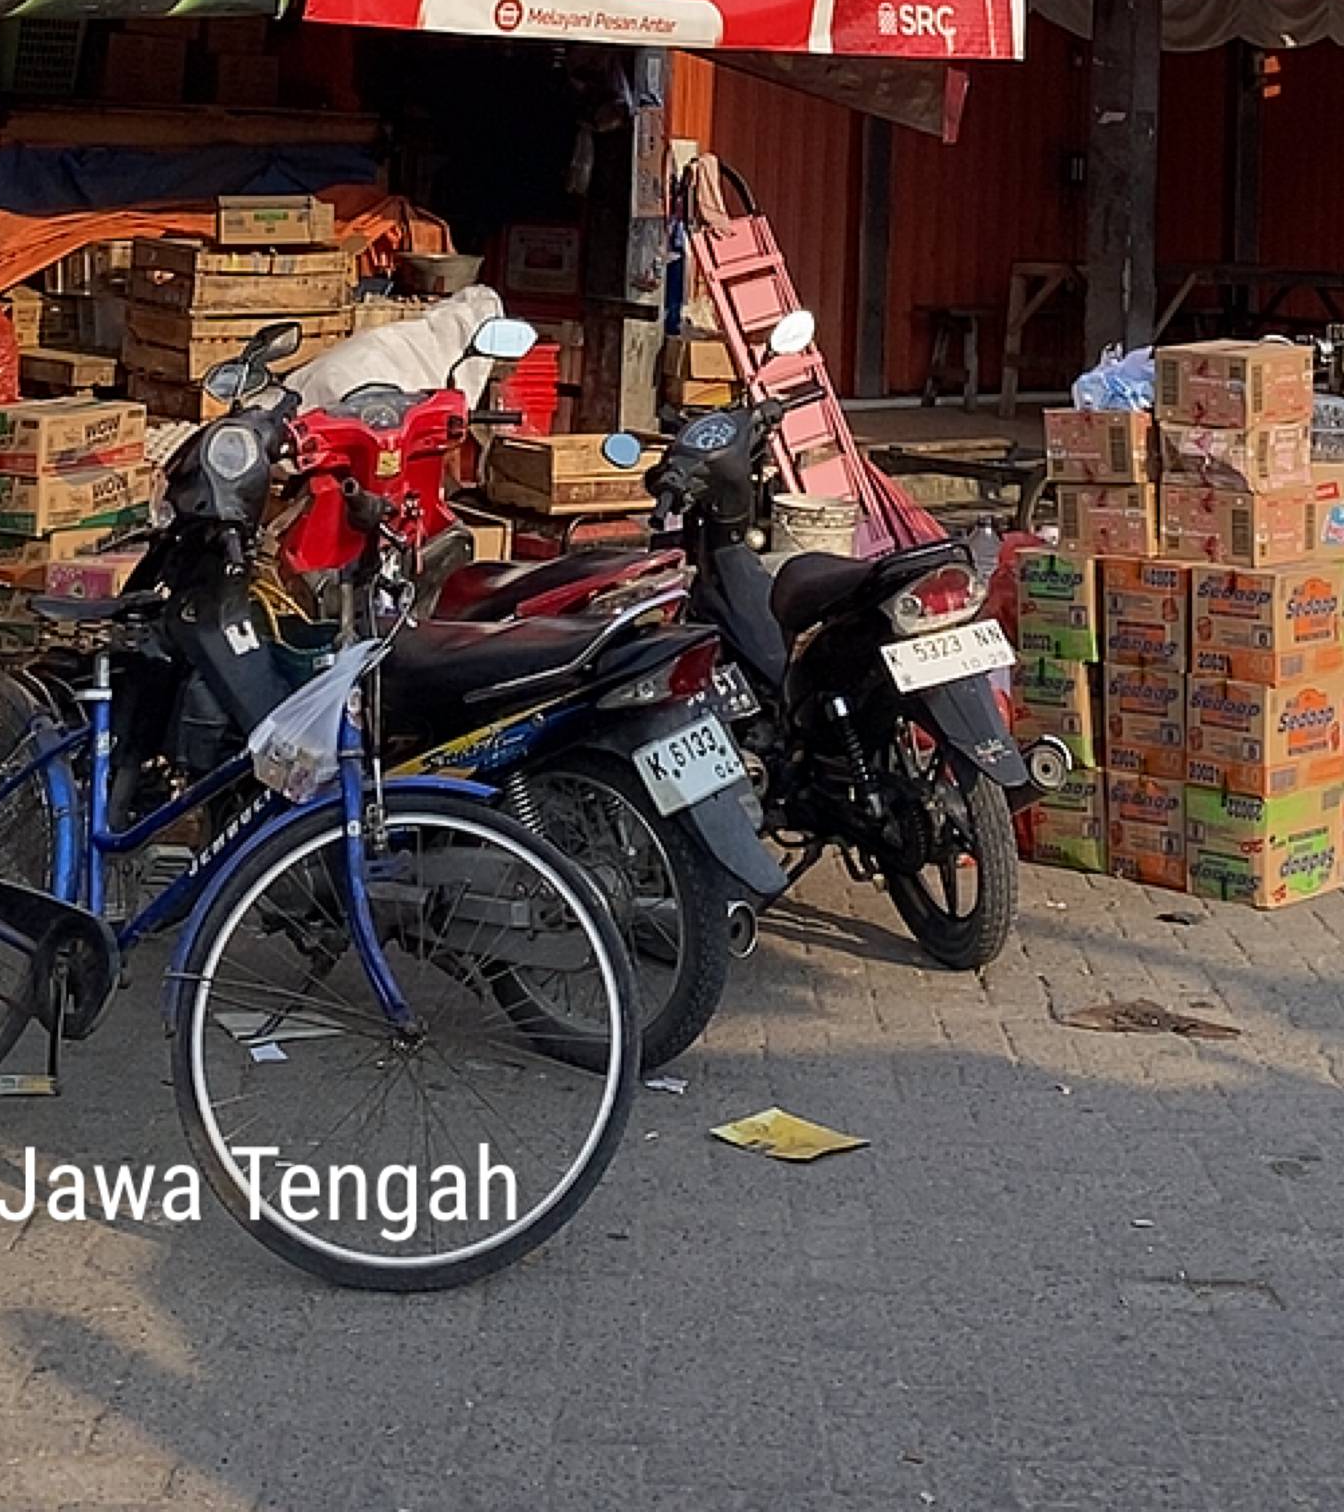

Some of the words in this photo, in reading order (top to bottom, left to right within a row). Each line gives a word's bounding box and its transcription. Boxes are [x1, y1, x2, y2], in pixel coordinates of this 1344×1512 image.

[526, 6, 592, 31] Melayani
[593, 11, 639, 32] Pesan
[639, 15, 678, 34] Antar
[898, 3, 957, 37] SRC
[887, 645, 904, 670] K
[974, 625, 1005, 648] NN
[644, 751, 670, 783] K
[671, 725, 717, 767] 6133
